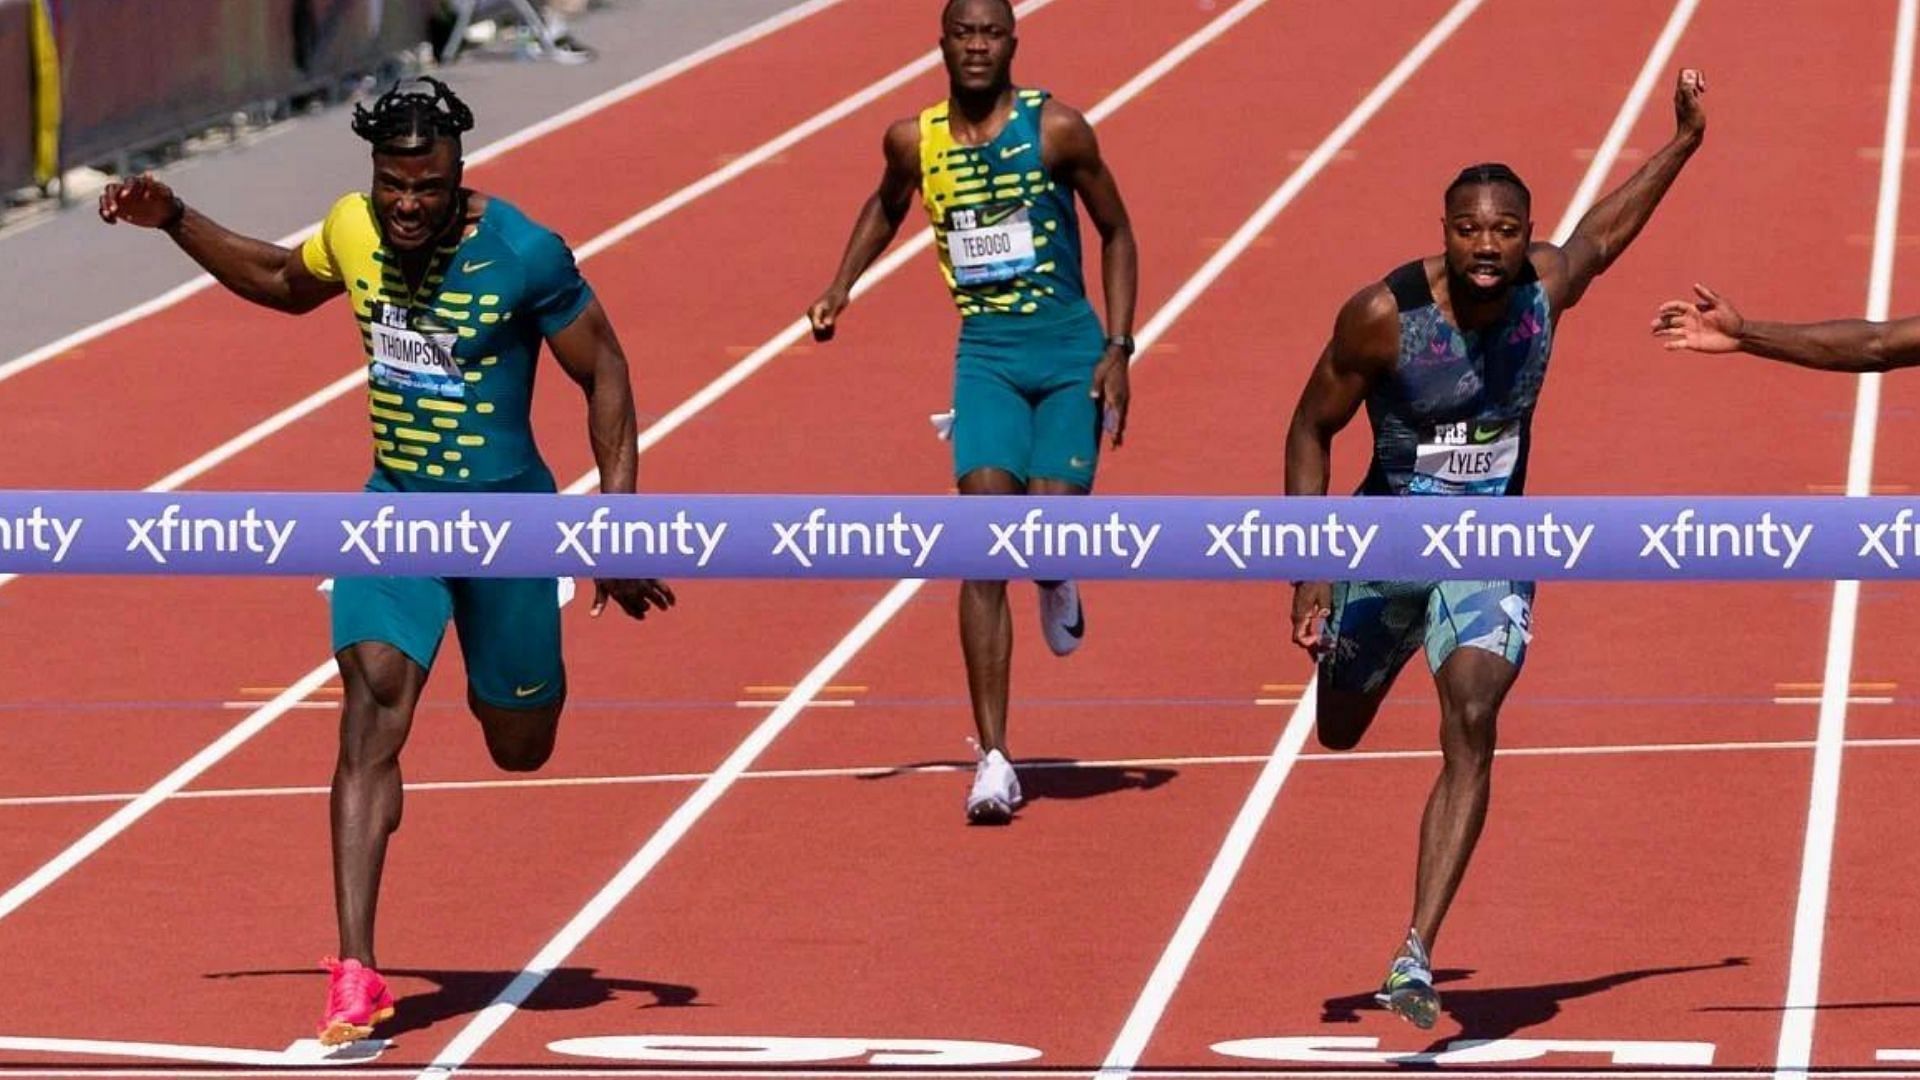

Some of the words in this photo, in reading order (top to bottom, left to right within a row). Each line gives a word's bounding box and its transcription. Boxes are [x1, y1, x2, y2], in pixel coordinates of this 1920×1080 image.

[962, 232, 1011, 258] TEBOGO
[380, 332, 451, 368] THOMPSON
[1434, 421, 1467, 445] PRE
[1447, 451, 1492, 475] LYLES
[127, 505, 296, 564] xfinity
[340, 506, 511, 565] xfinity
[556, 507, 727, 566] xfinity
[772, 508, 943, 567] xfinity
[988, 509, 1161, 568] xfinity
[1206, 509, 1379, 569] xfinity
[1423, 509, 1595, 569] xfinity
[1640, 509, 1813, 569] xfinity
